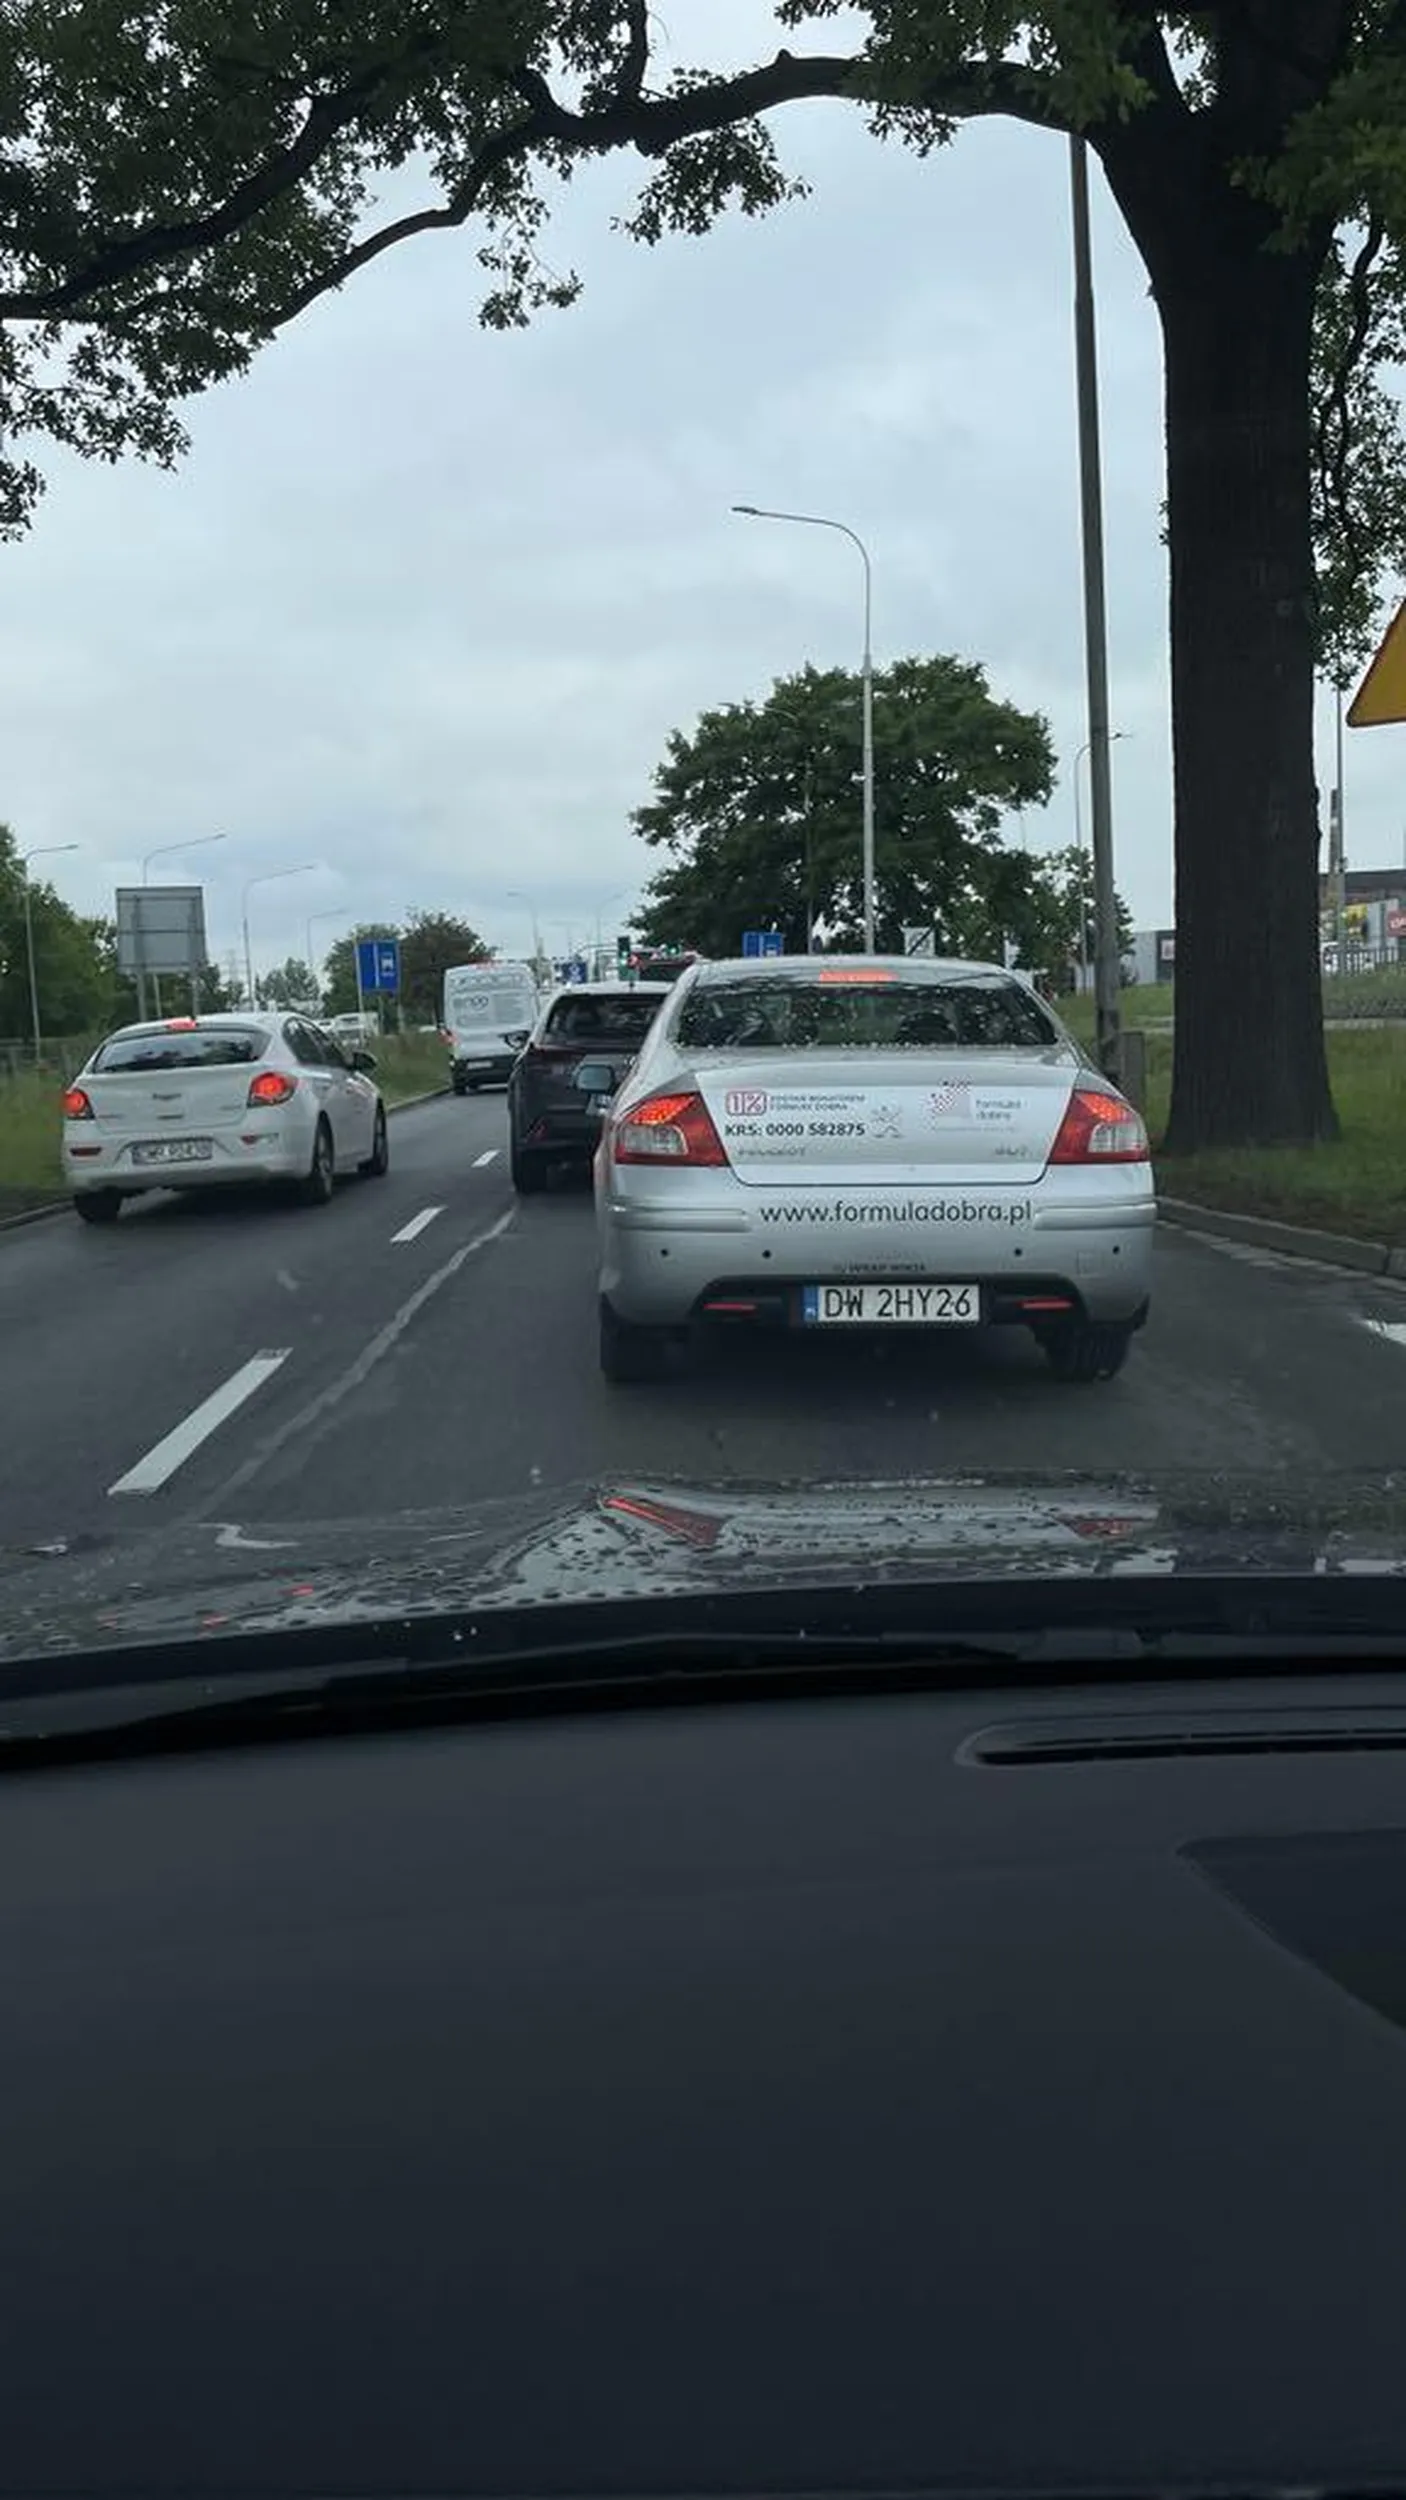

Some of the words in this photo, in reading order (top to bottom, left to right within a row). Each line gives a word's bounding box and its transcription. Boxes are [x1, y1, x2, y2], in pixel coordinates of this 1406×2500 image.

[725, 1123, 762, 1136] KRS:
[766, 1123, 804, 1136] 0000
[809, 1123, 866, 1136] 582875
[760, 1200, 1033, 1226] www.formuladobra.pl
[825, 1288, 864, 1317] DW
[877, 1288, 972, 1317] 2HY26
